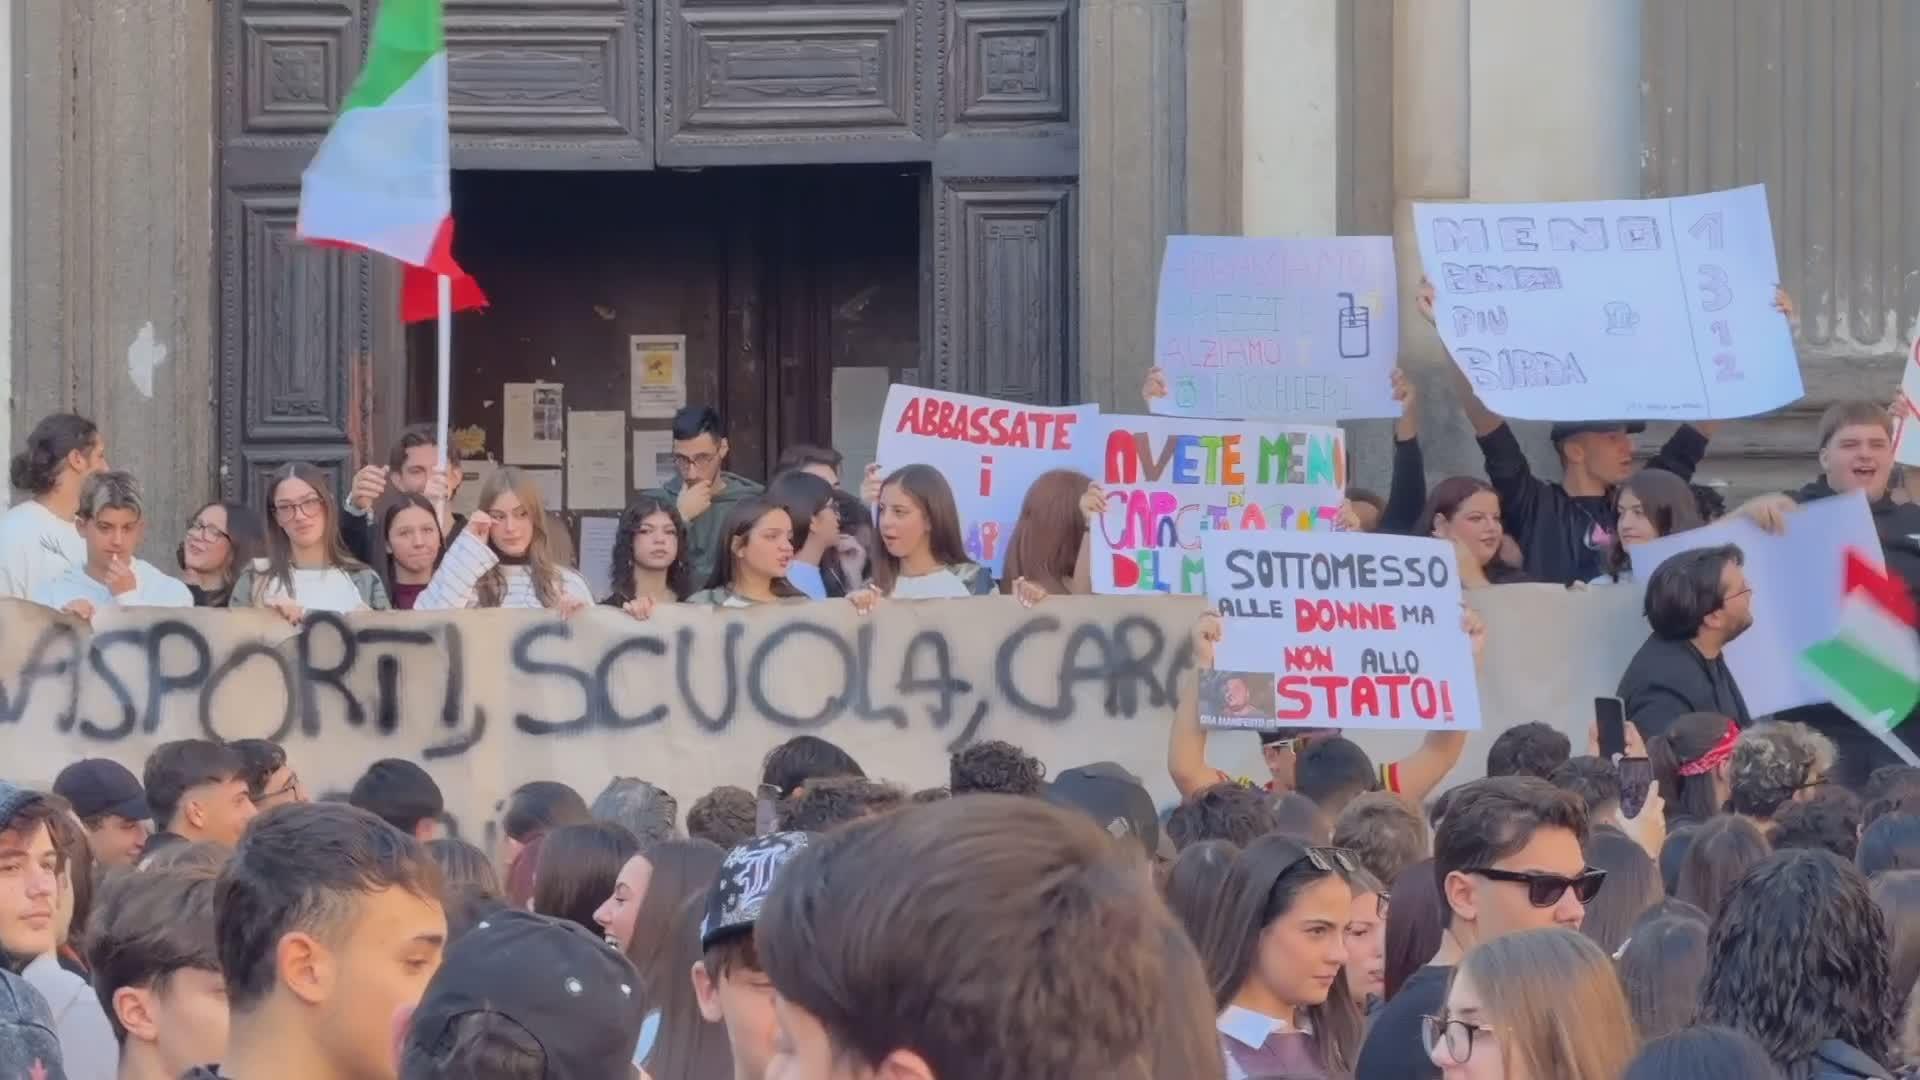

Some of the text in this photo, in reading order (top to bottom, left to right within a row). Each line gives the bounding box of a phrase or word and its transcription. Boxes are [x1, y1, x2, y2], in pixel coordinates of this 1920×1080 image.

[1433, 215, 1661, 251] MENO
[1688, 210, 1725, 250] 1
[1163, 337, 1281, 368] ALZIAMO
[1456, 347, 1587, 391] BIRRA
[896, 397, 1077, 451] ABBASSATE
[1105, 429, 1245, 486] AVETE
[1112, 550, 1207, 596] DEL M
[1225, 549, 1449, 590] SOTTOMESSO
[1219, 597, 1435, 633] ALLE DONNE MA
[1283, 645, 1420, 674] NON ALLO
[510, 620, 989, 752] SCUOLA,
[1276, 675, 1455, 722] STATO!
